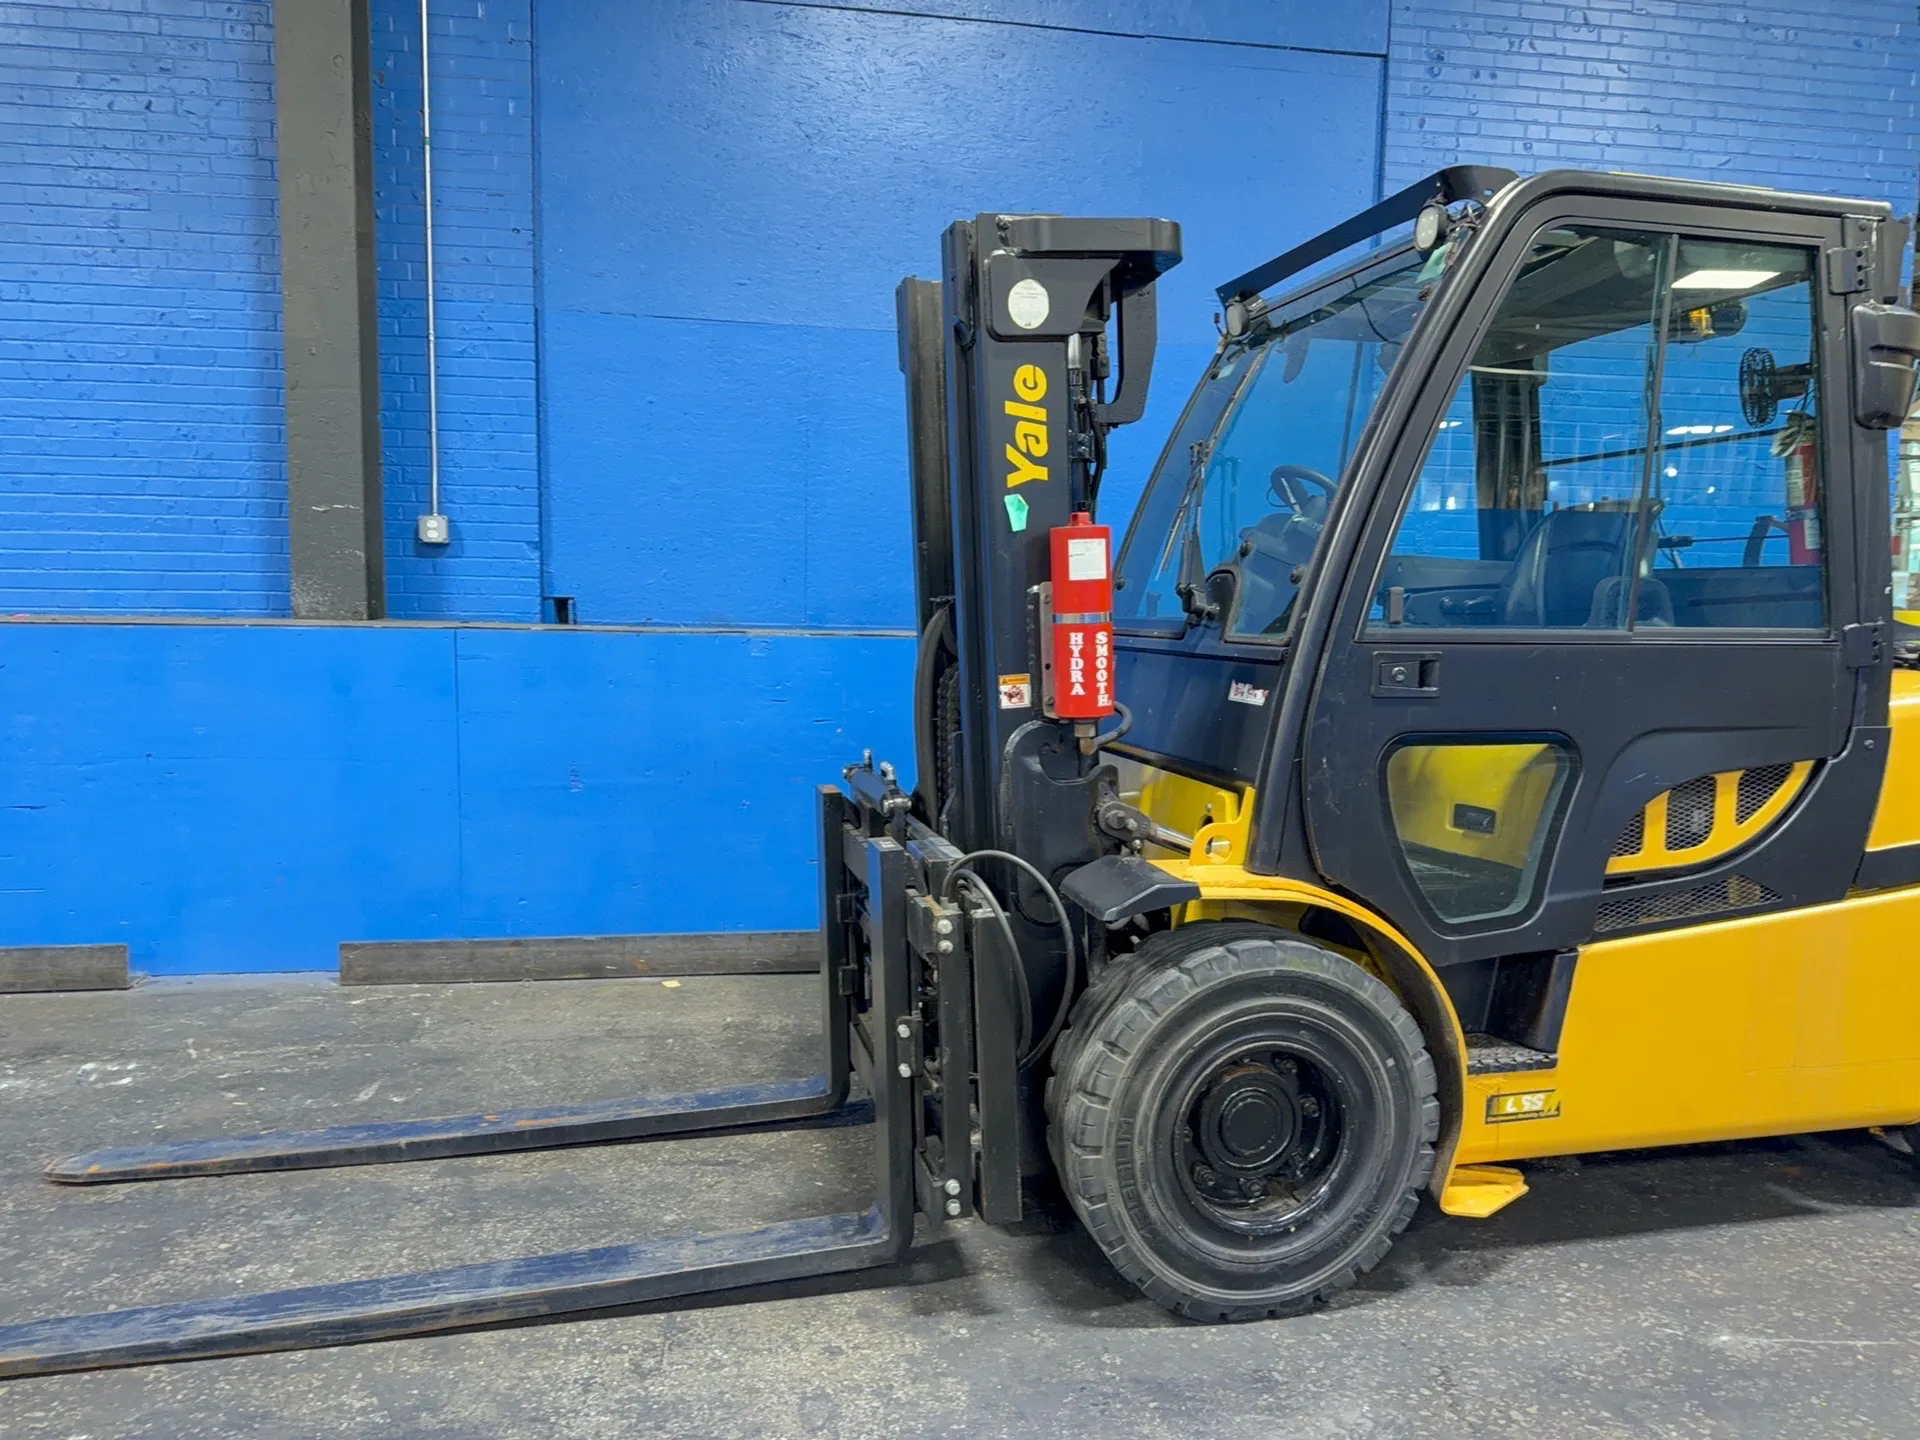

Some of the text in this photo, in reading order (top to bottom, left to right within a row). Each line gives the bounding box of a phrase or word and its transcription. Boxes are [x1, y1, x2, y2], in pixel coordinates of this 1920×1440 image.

[1004, 364, 1049, 488] Yale
[1069, 632, 1086, 696] HYDRA
[1095, 631, 1110, 707] SMOOTH
